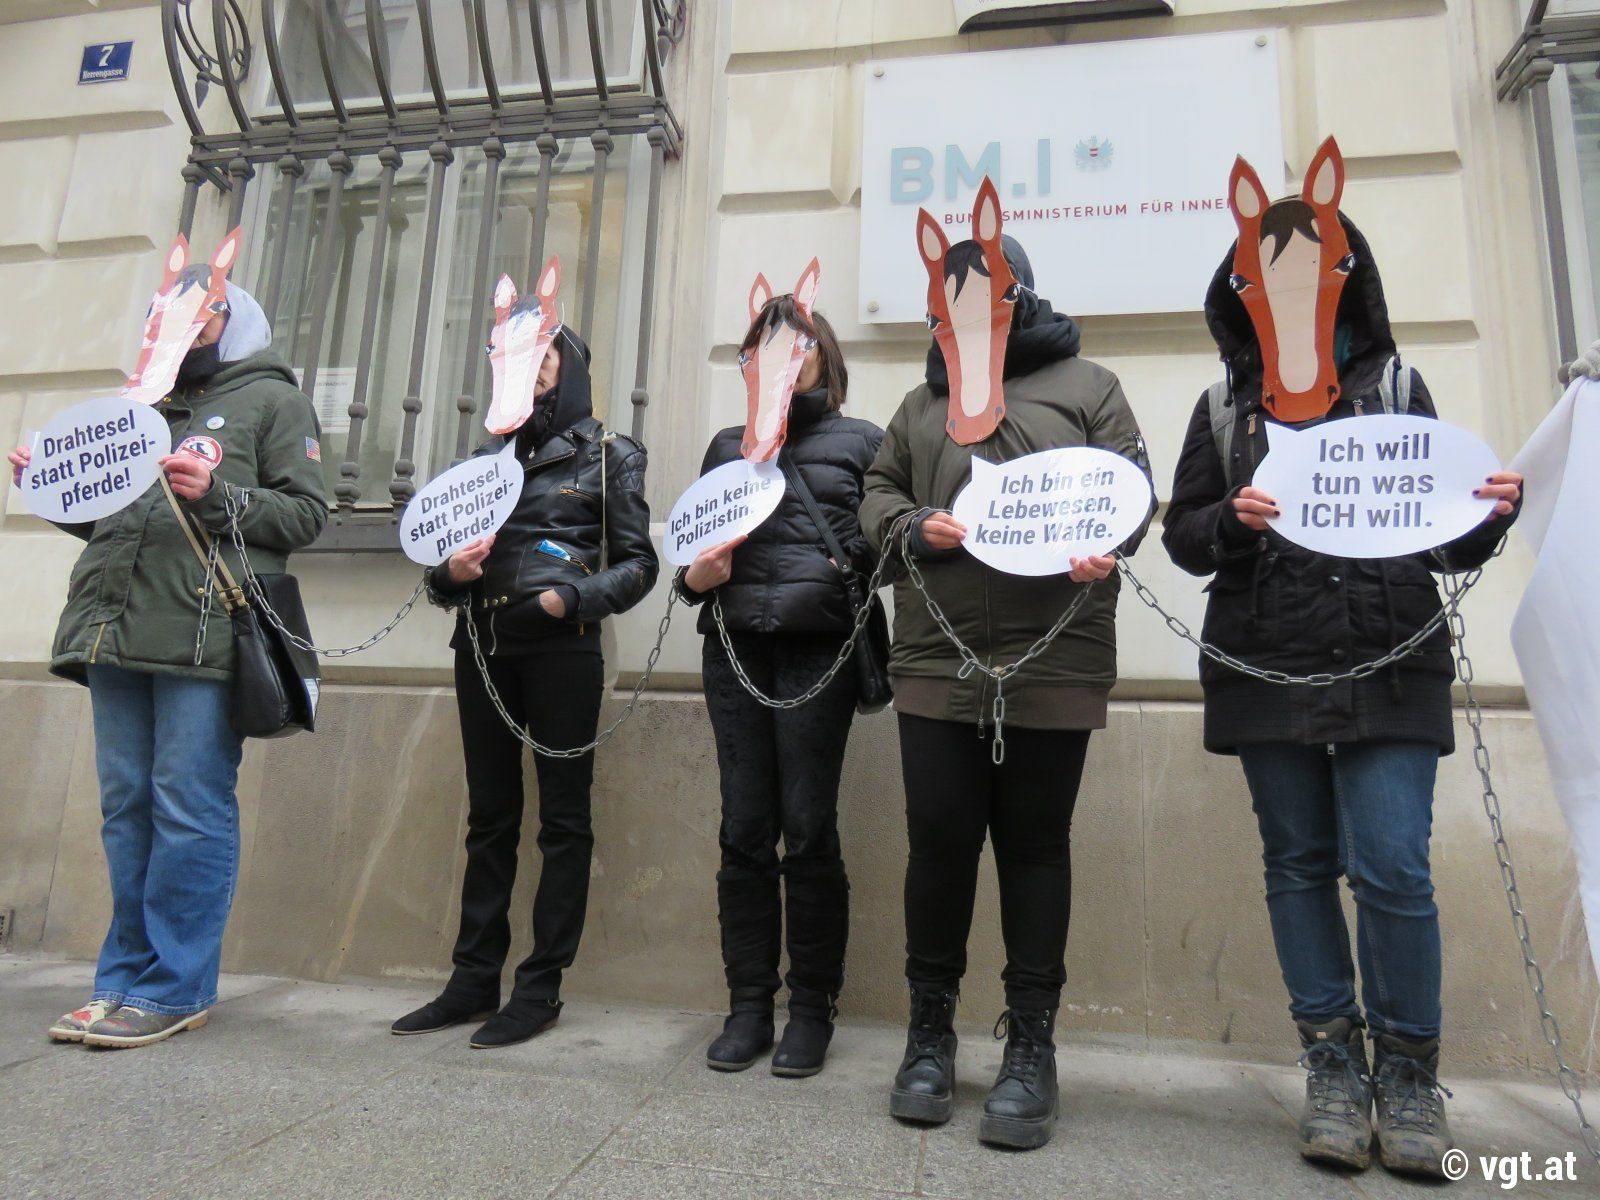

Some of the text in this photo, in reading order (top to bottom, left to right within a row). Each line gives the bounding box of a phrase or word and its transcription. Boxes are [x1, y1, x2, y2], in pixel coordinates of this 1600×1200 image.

[82, 68, 124, 80] Herrengasse
[98, 44, 115, 67] 7
[890, 138, 1051, 205] BM.I
[944, 198, 1231, 225] BUNSMINISTERIUM FÜR INNE
[43, 409, 136, 458] Drahtesel
[1319, 432, 1430, 462] Ich will
[31, 459, 75, 490] statt
[79, 433, 156, 474] Polizei-
[1001, 466, 1115, 495] Ich bin ein
[61, 467, 131, 513] pferde!
[420, 462, 500, 514] Drahtesel
[1312, 472, 1434, 495] tun was
[410, 479, 514, 542] statt Polizei-
[671, 478, 771, 536] Ich bin keine
[988, 495, 1117, 519] Lebewesen,
[1301, 501, 1433, 528] ICH will.
[436, 510, 495, 557] pferde!
[676, 504, 755, 552] Polizistin.
[975, 518, 1113, 545] keine Waffe.
